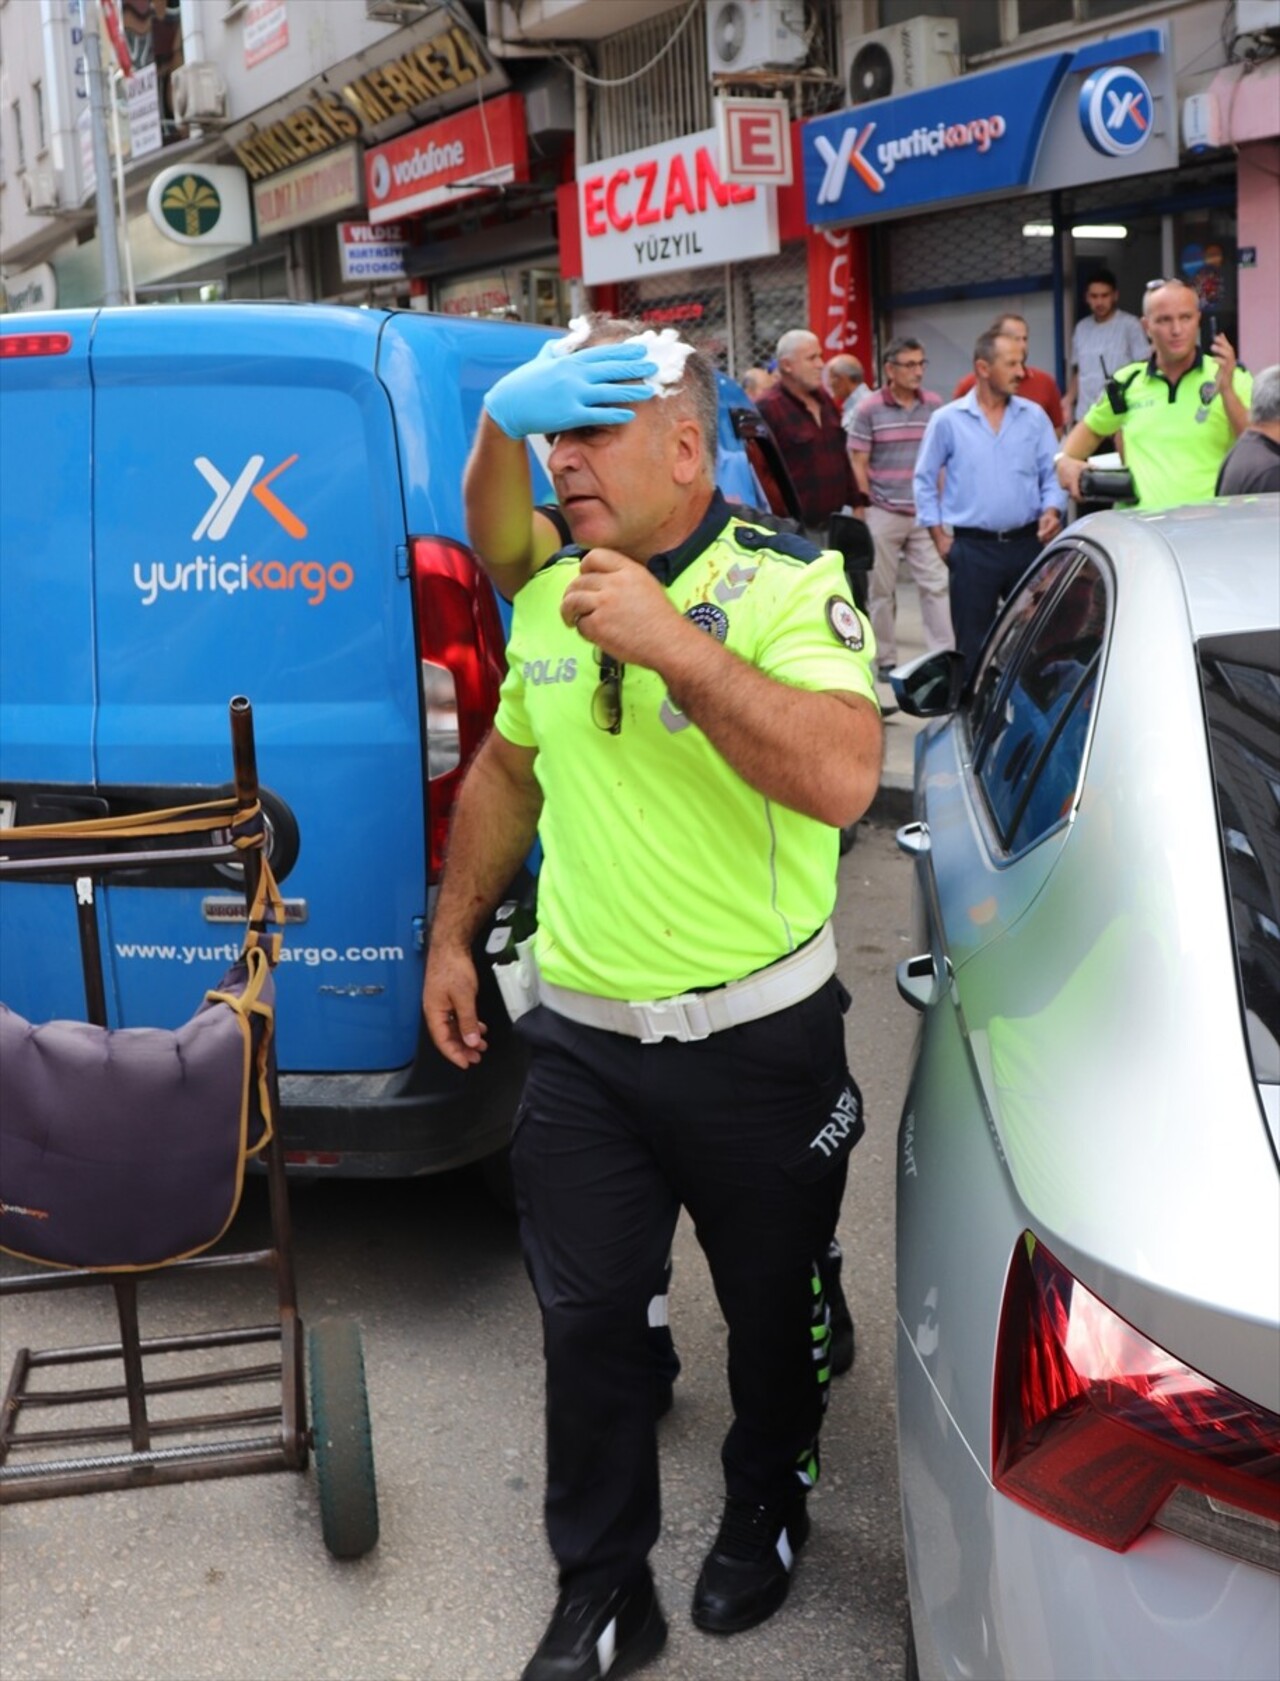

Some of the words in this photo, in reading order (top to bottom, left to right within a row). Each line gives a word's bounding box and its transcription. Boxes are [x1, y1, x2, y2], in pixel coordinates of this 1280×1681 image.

[393, 140, 465, 185] vodafone
[739, 117, 775, 166] E
[583, 145, 757, 238] ECZAN
[634, 231, 704, 264] YÜZYIL
[133, 554, 354, 606] yurtiçikargo
[115, 941, 405, 966] www.yurtiargo.com
